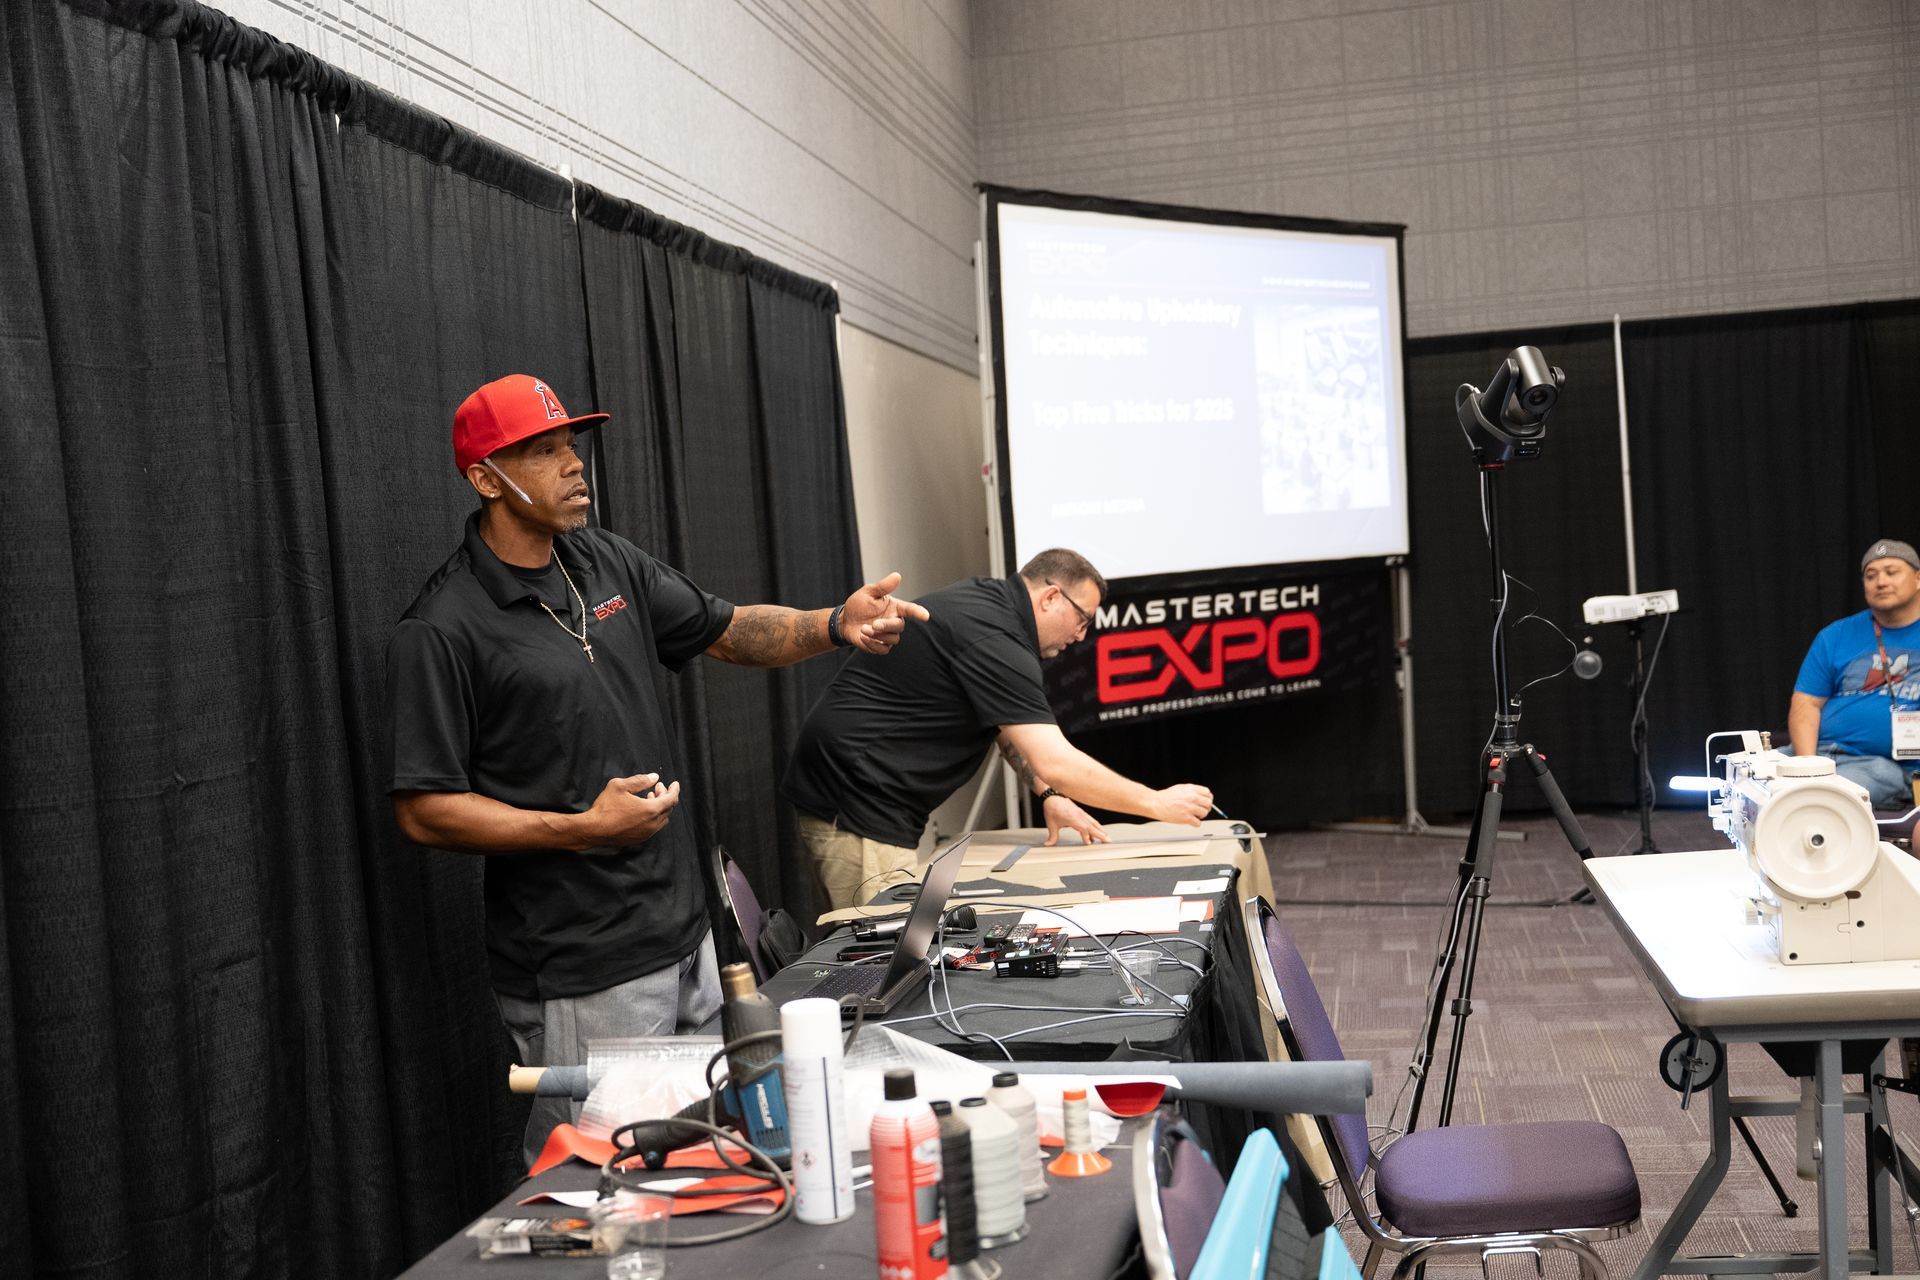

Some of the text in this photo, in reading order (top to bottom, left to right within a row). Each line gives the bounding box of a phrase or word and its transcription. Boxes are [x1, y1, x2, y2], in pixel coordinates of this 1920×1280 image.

[1028, 293, 1242, 328] Automotive Upholstery
[1032, 398, 1234, 431] Top Five Tricks for 2025
[595, 598, 627, 620] EXPO
[1097, 611, 1322, 704] EXPO
[1098, 679, 1322, 721] WHERE PROFESSIONALS COME TO LEARN
